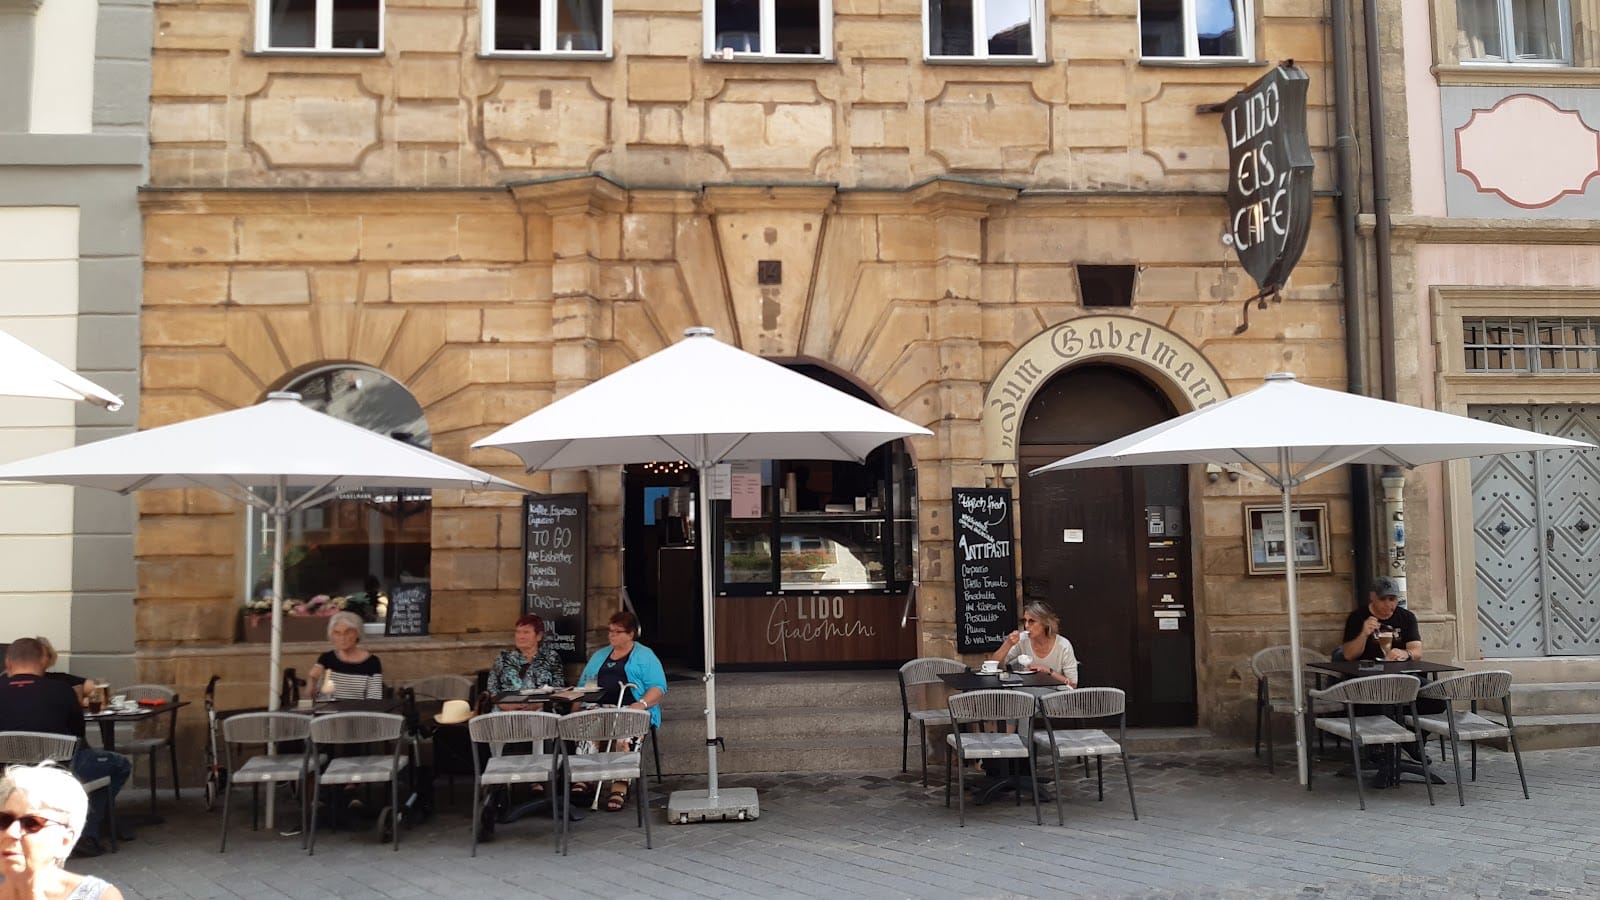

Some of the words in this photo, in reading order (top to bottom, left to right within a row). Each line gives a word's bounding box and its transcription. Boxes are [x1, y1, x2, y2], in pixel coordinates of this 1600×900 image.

[1231, 81, 1280, 149] LIDO
[1237, 140, 1275, 197] EIS
[1233, 171, 1288, 251] CAFÉ
[531, 529, 549, 546] TO
[553, 527, 572, 549] GO
[958, 534, 1010, 561] ANTIPASTI
[527, 593, 560, 609] TOAST
[797, 596, 844, 620] LIDO
[766, 598, 876, 662] Giacomini
